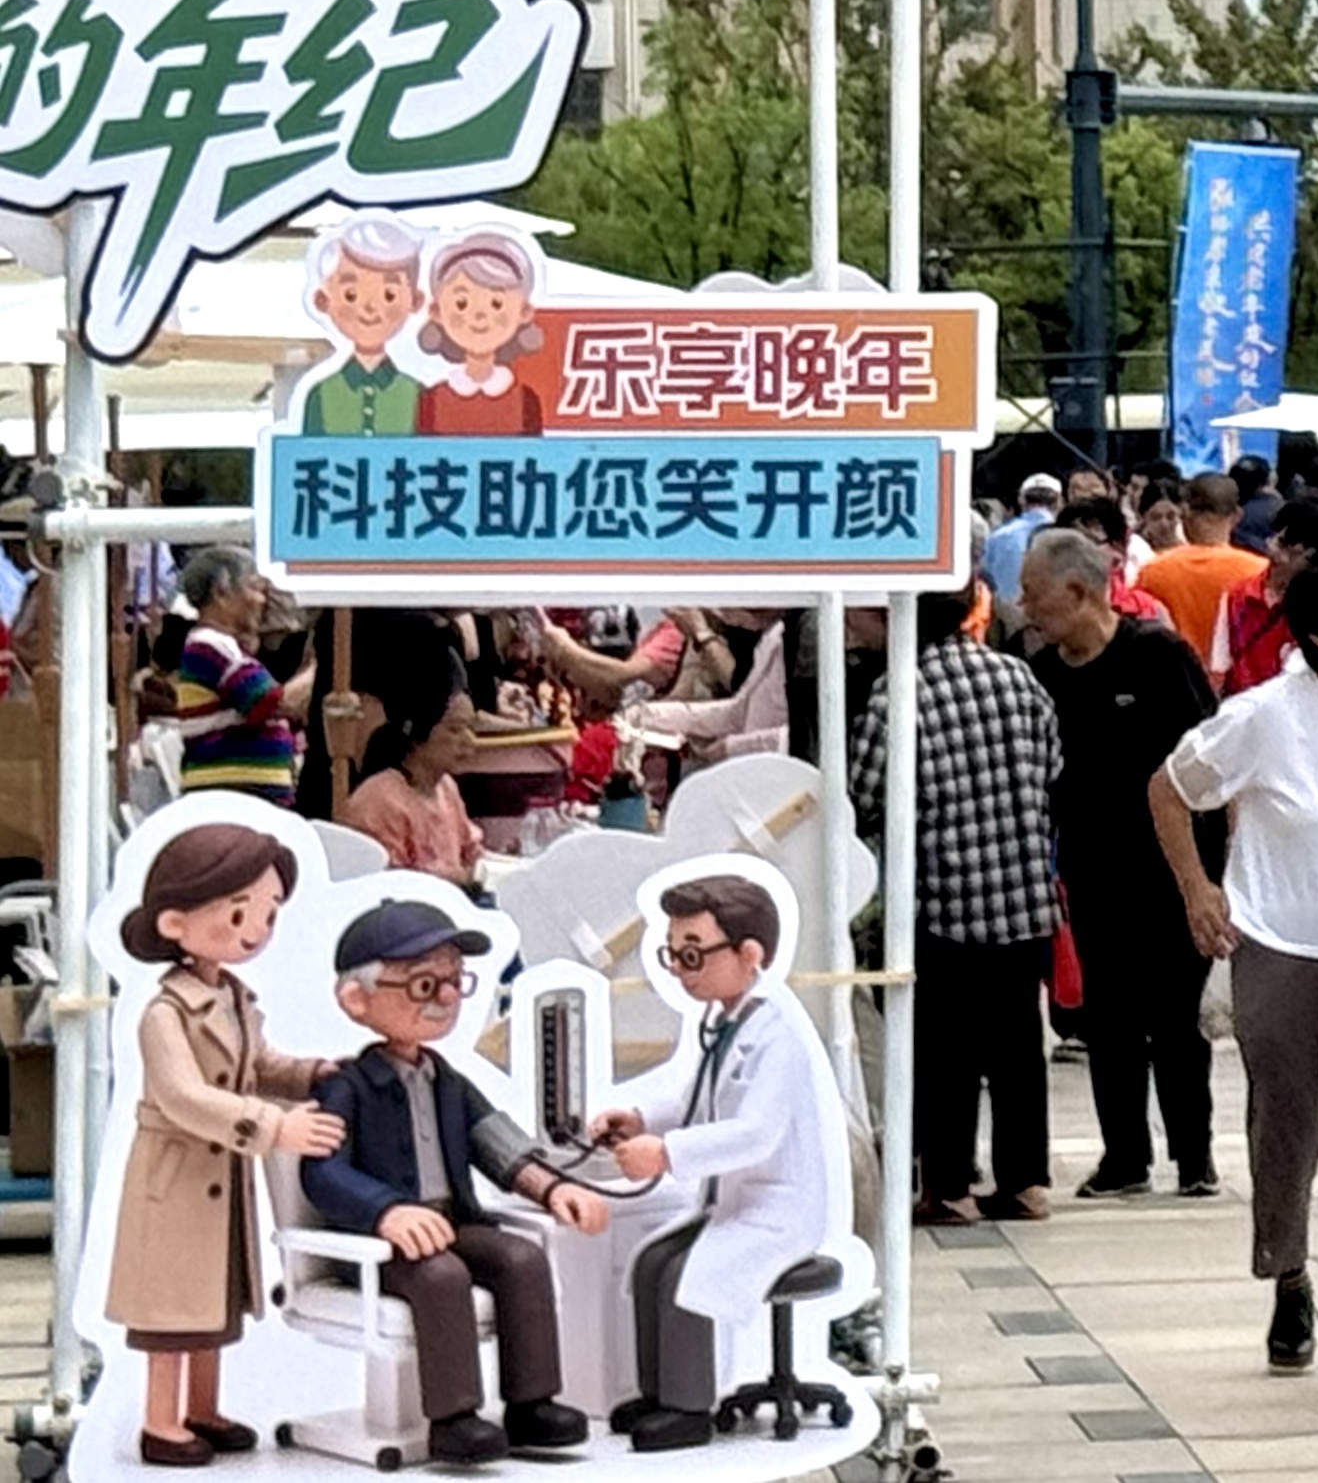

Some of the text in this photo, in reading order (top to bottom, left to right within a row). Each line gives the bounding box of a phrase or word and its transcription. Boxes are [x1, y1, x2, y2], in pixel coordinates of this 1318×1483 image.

[559, 326, 936, 418] 乐享晚年
[291, 457, 920, 540] 科技助您笑开颜
